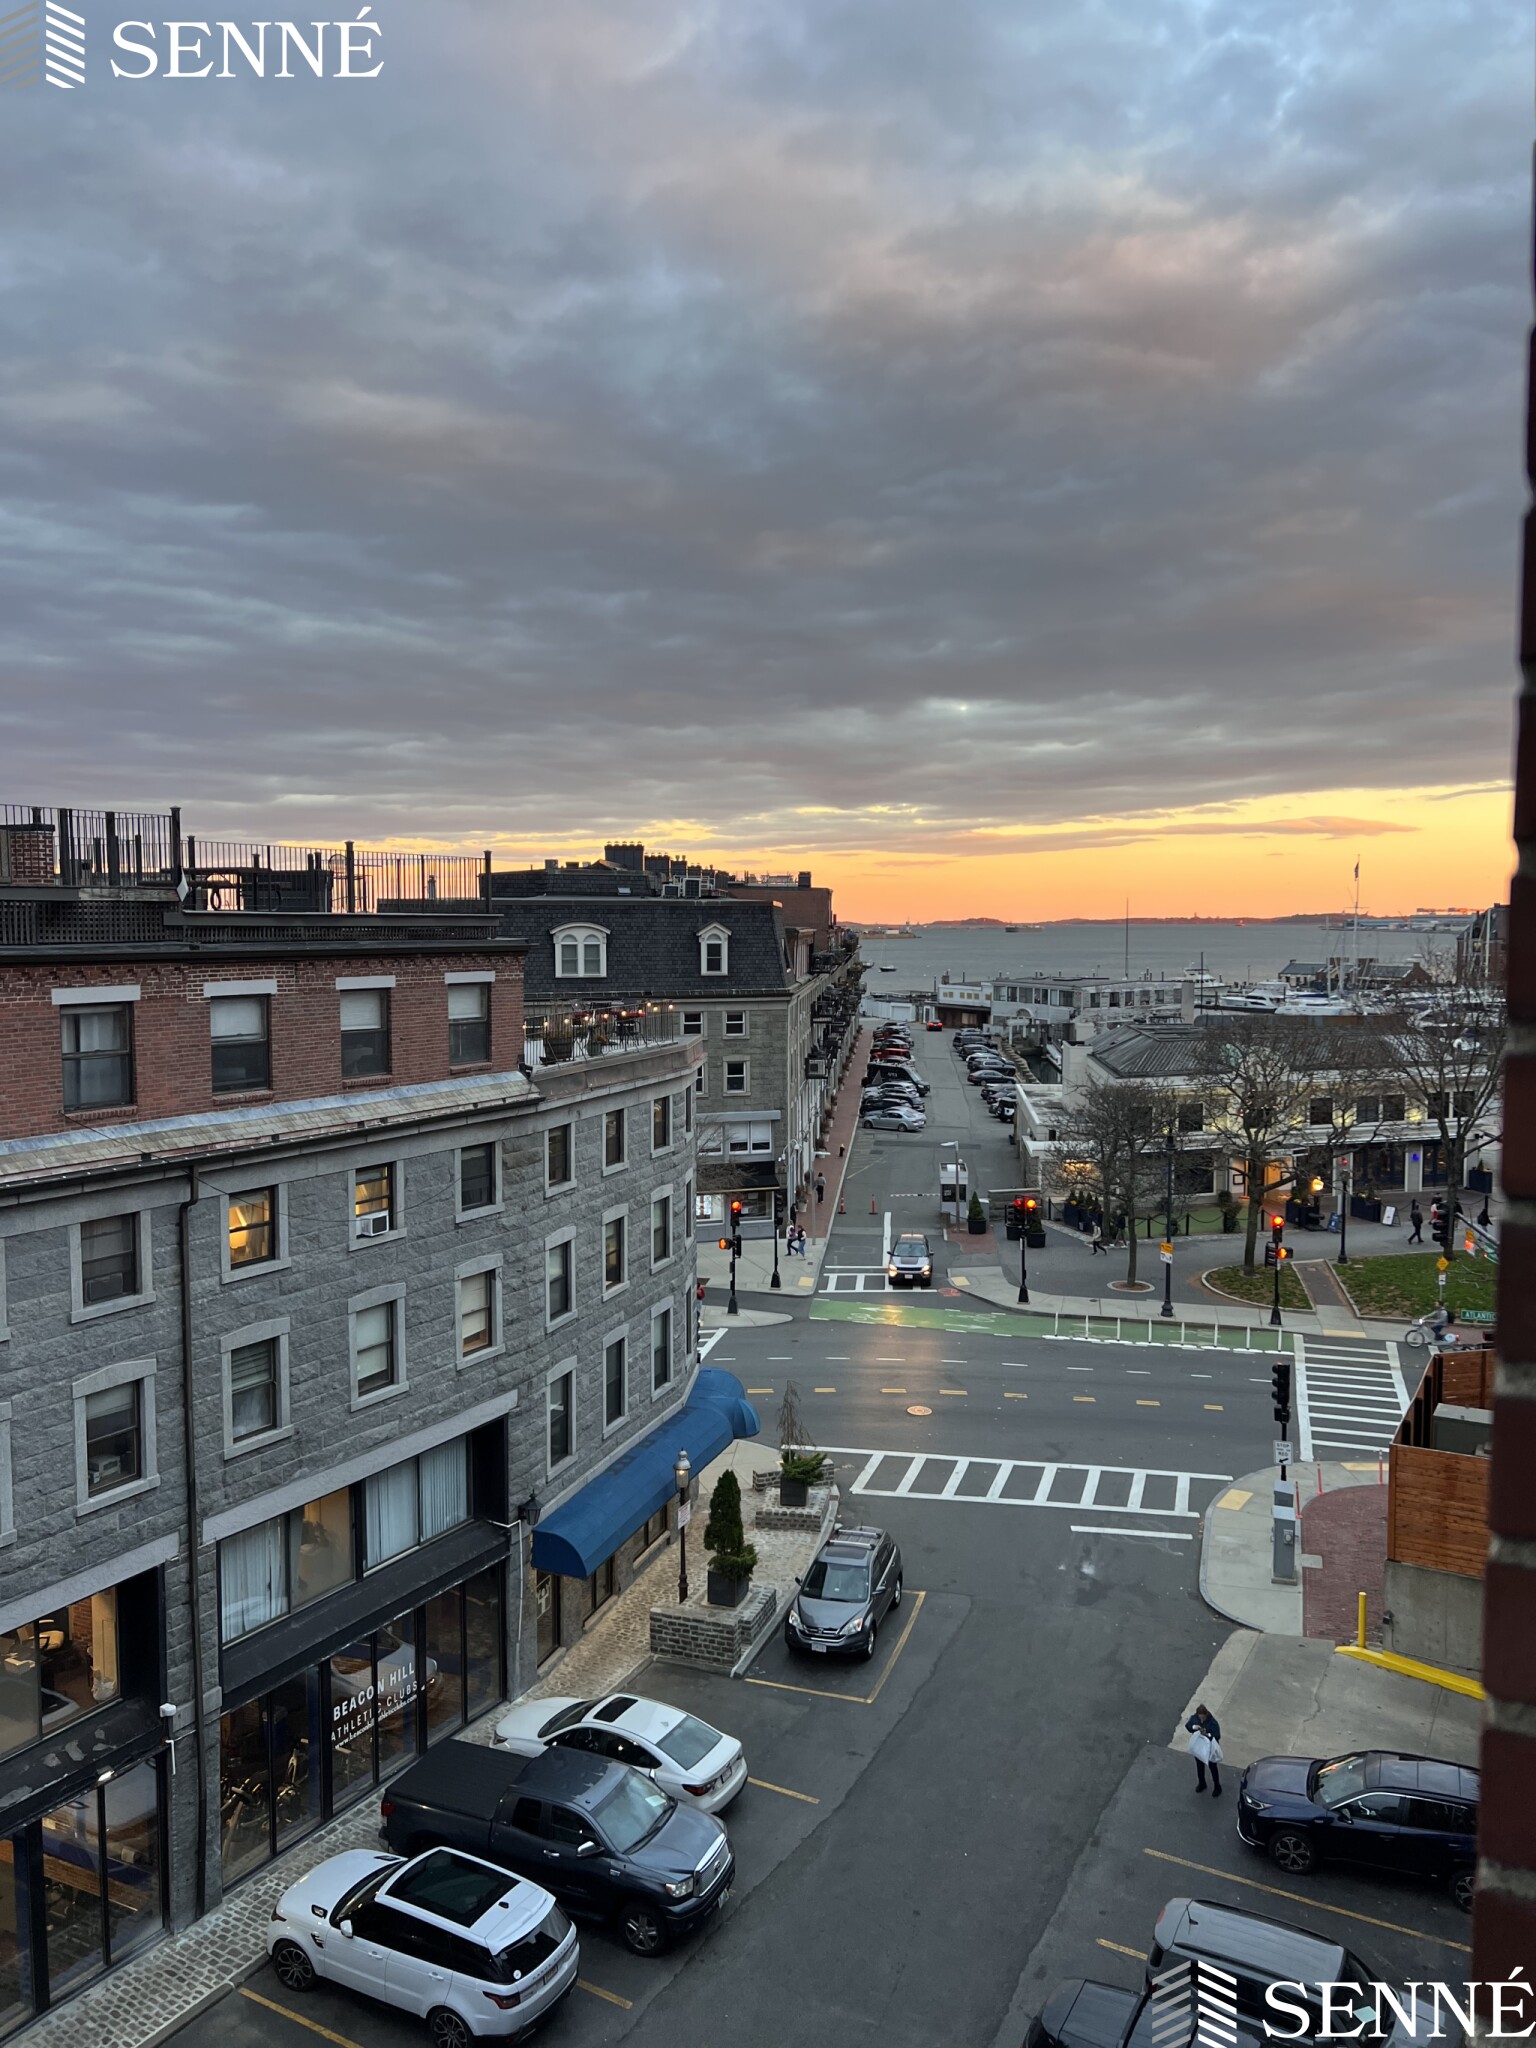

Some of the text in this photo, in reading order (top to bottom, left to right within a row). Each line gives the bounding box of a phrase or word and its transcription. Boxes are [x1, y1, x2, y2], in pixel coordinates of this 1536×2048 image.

[333, 1662, 415, 1721] BEACON HILL
[387, 1680, 418, 1707] CLUBS
